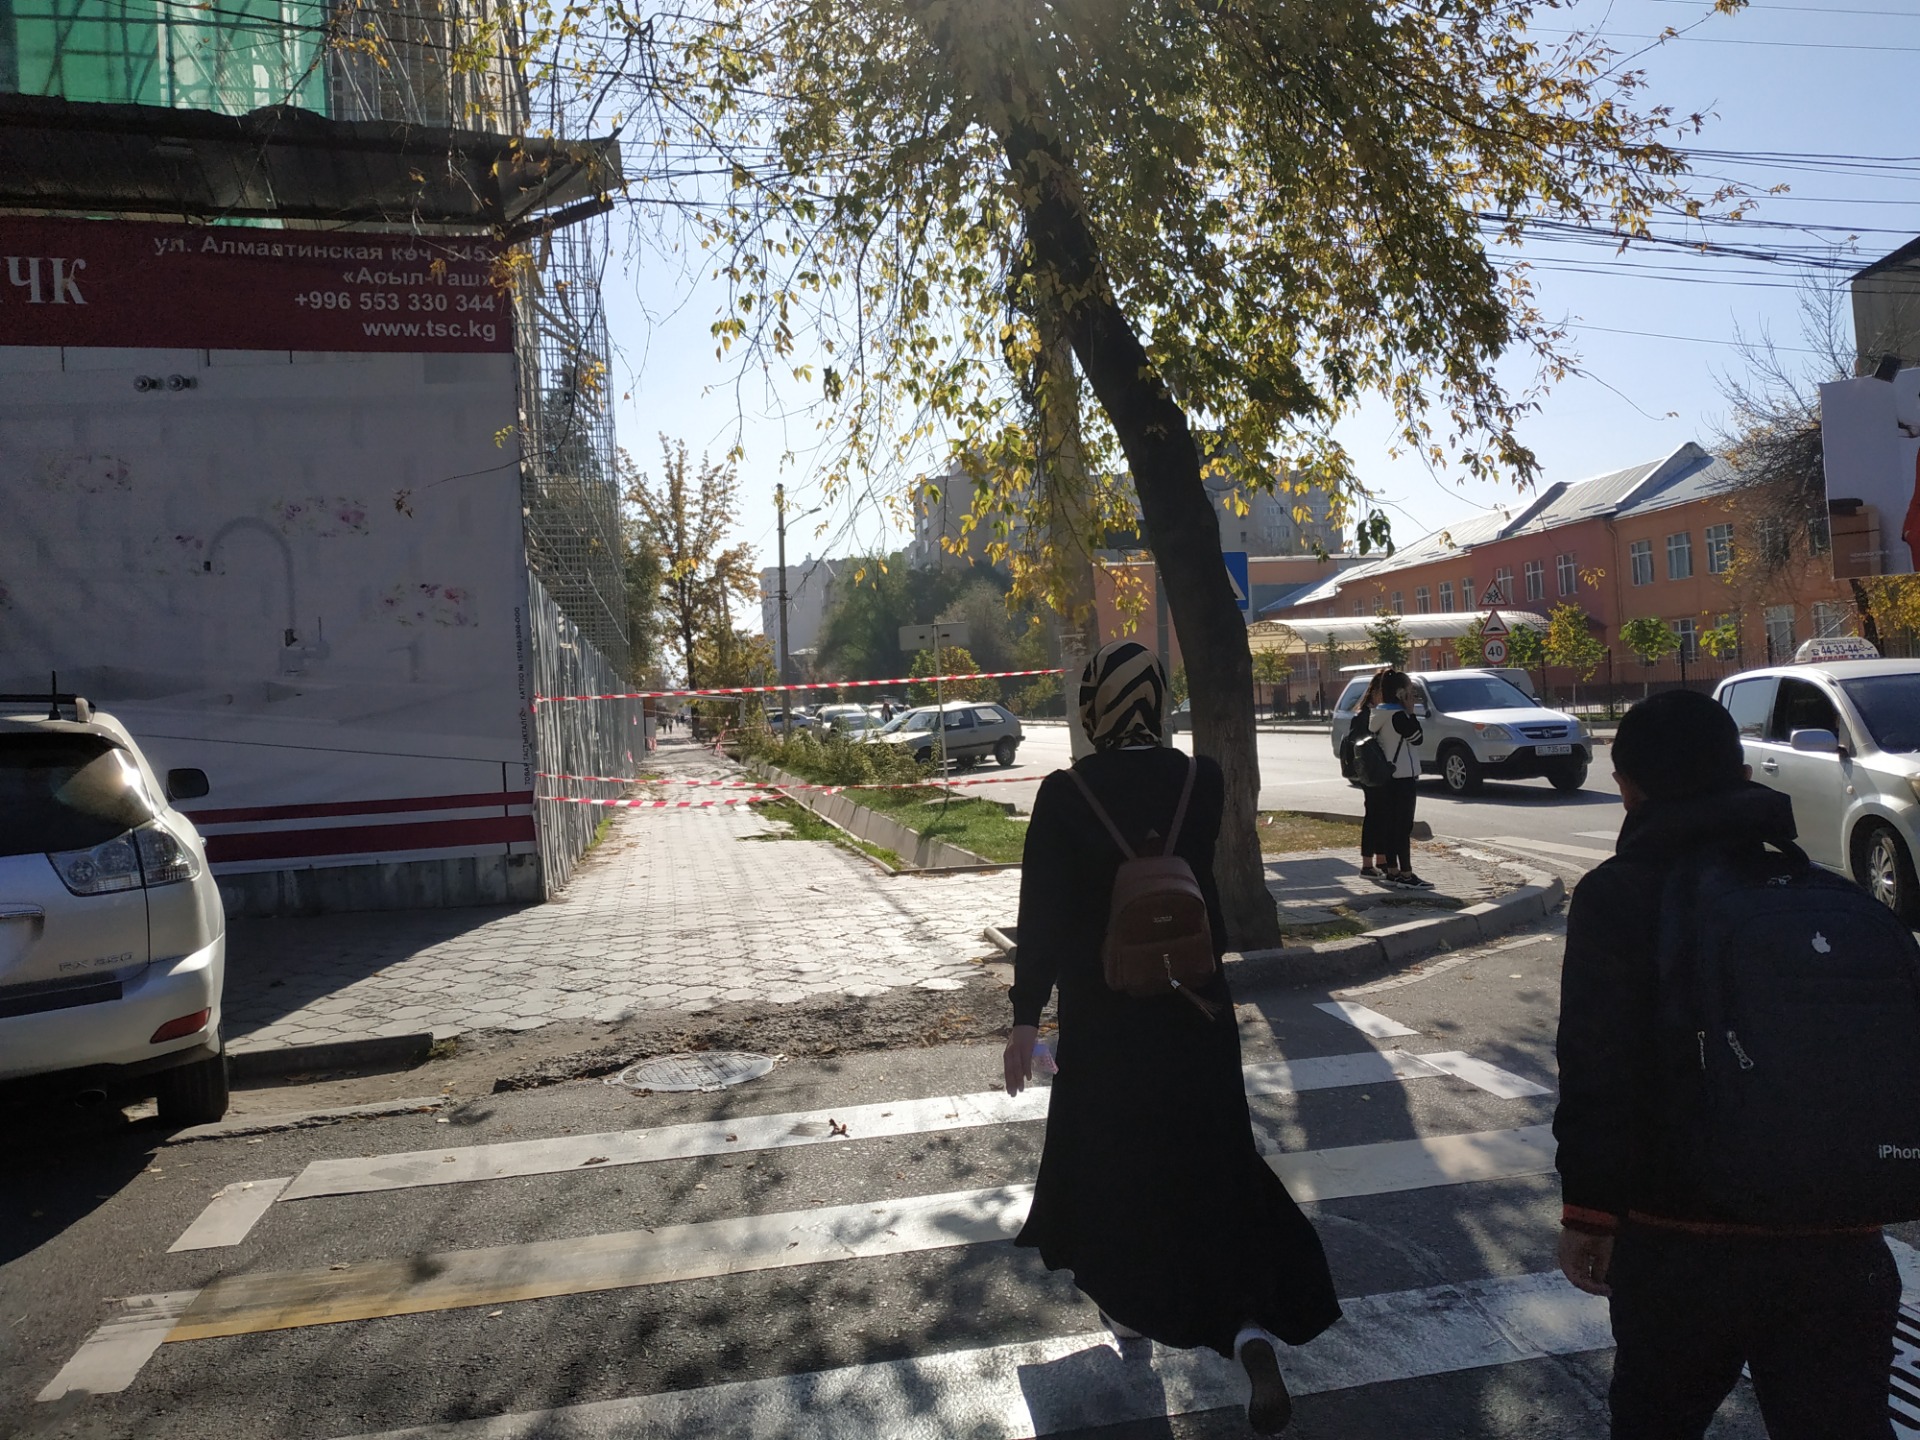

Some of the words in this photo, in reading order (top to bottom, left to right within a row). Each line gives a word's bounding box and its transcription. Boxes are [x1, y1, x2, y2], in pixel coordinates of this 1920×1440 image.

[154, 236, 192, 256] ул.
[201, 235, 384, 261] Алмаатинская
[0, 255, 88, 305] ЧК
[294, 290, 352, 310] +996
[359, 292, 400, 311] 553
[407, 293, 448, 312] 330
[455, 294, 496, 313] 344
[361, 319, 497, 343] www.tsc.kg
[1487, 645, 1504, 657] 40
[520, 707, 530, 761] ТАСТЫКТАЛГА
[58, 959, 88, 973] RX
